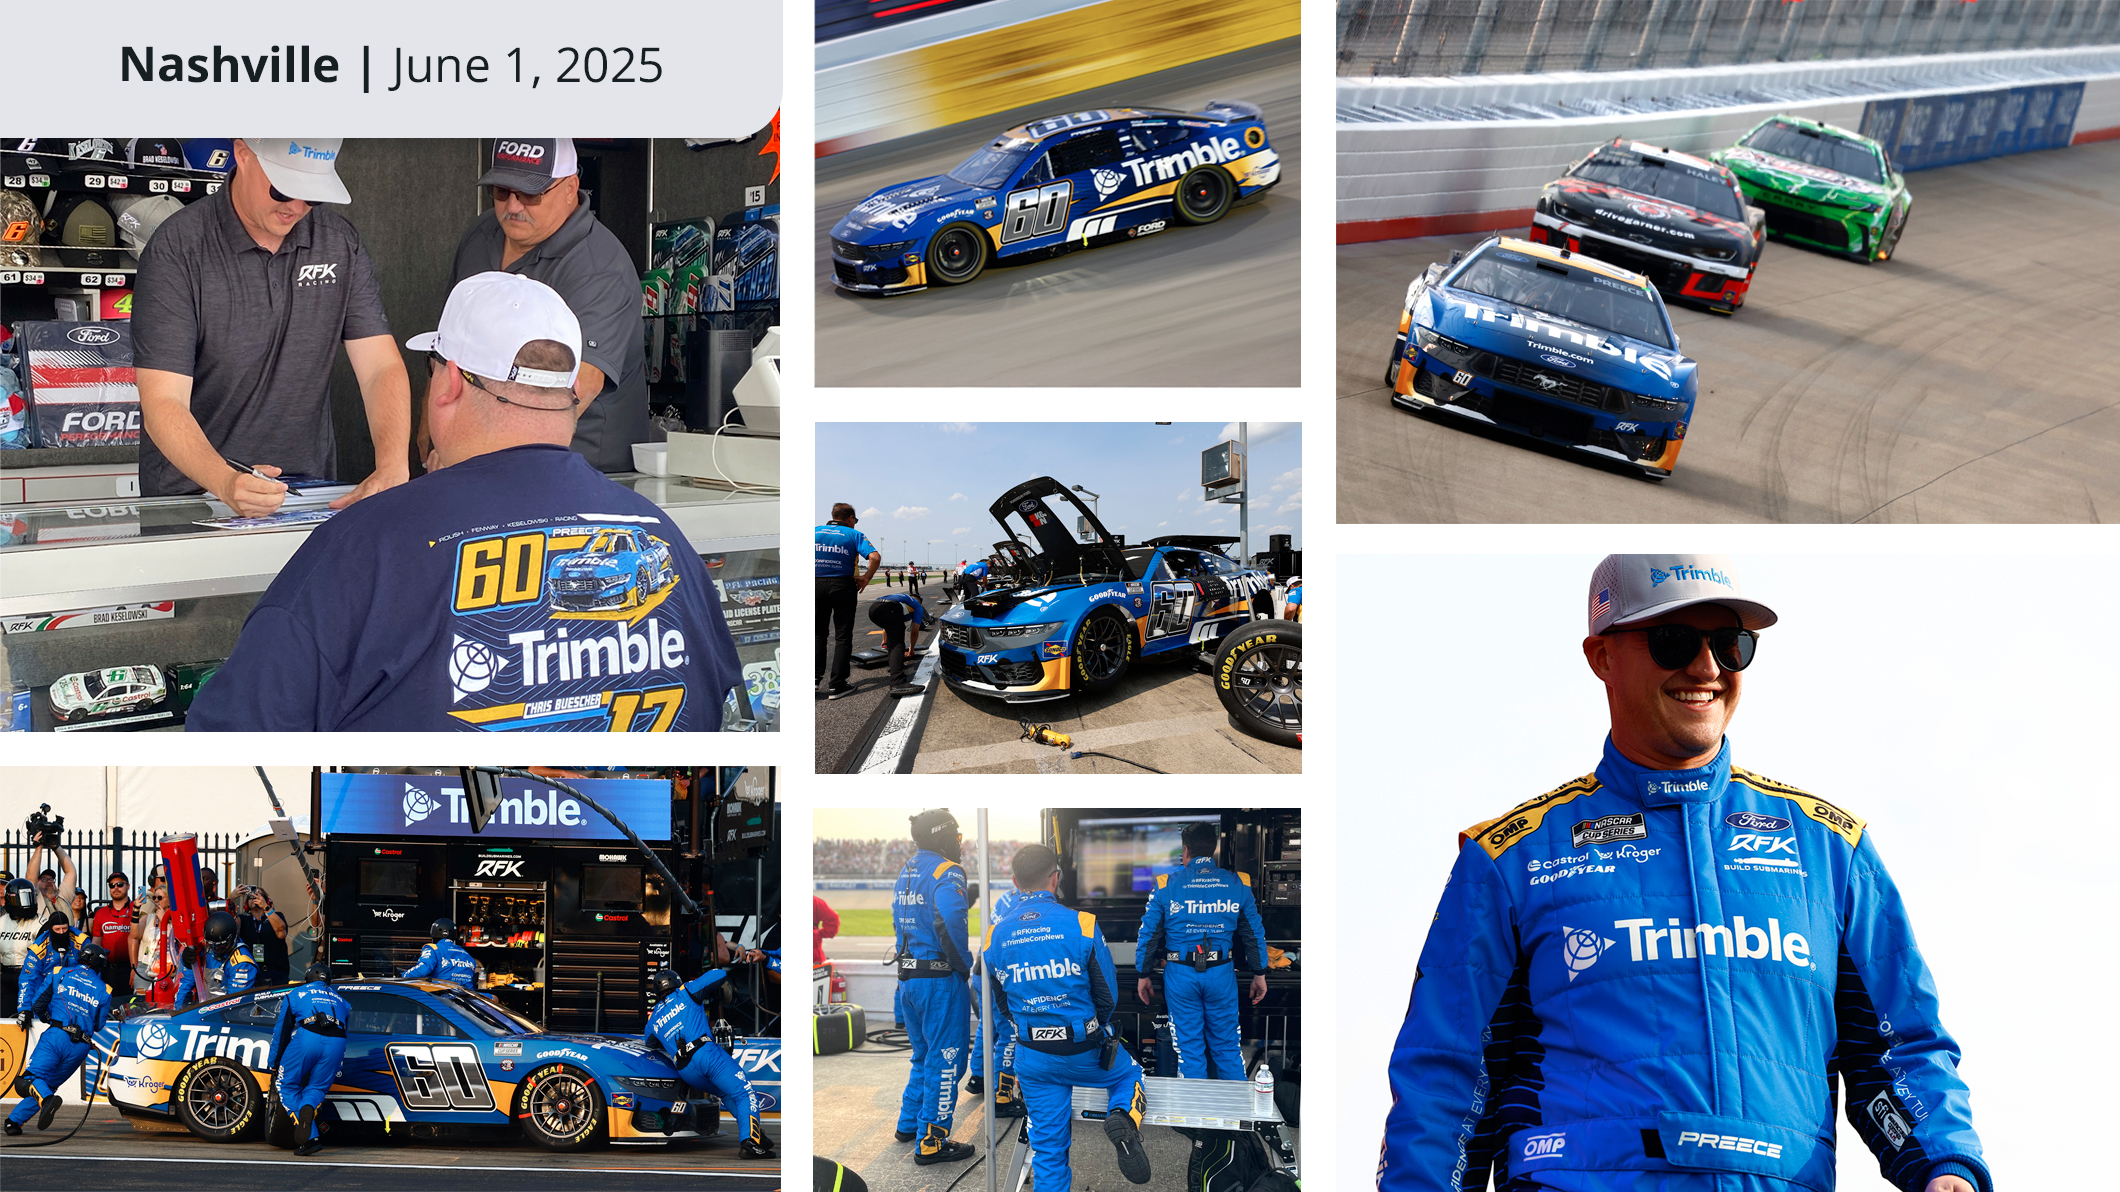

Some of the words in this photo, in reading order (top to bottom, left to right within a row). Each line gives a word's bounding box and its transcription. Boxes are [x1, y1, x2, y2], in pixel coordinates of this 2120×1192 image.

[1071, 126, 1102, 137] PREECE
[303, 145, 336, 160] Trimble
[498, 140, 545, 159] FORD
[207, 149, 230, 169] 6
[1121, 136, 1241, 187] Trimble
[89, 178, 102, 186] 29
[1687, 168, 1727, 185] HALEY
[153, 182, 165, 190] 30
[936, 208, 975, 224] GOODYEAR
[1001, 182, 1072, 245] 60
[2, 221, 29, 241] 6
[1137, 220, 1166, 233] FORD
[1595, 208, 1696, 239] drivegarner.com
[86, 276, 98, 284] 62
[298, 264, 338, 281] RFK
[298, 279, 338, 287] RACING
[1593, 277, 1644, 297] PREECE
[78, 328, 110, 342] Ford
[1464, 303, 1672, 382] Trimble
[1527, 340, 1594, 365] Trimble.com
[1549, 356, 1568, 367] Ford
[1453, 371, 1472, 387] 60
[60, 430, 140, 441] PERFORMANC
[1615, 422, 1639, 433] RFK
[438, 531, 464, 543] ROUSH
[471, 524, 499, 533] FENWAY
[507, 518, 548, 528] KESELOWSKI
[552, 527, 601, 537] PREECE
[815, 543, 849, 555] Trimble
[455, 534, 546, 611] 60
[1670, 564, 1732, 589] Trimble
[1089, 588, 1127, 602] GOODYEAR
[735, 606, 761, 618] LICENSE
[1148, 582, 1194, 639] 60
[10, 621, 33, 632] RFK
[93, 612, 110, 624] BRAD
[110, 608, 148, 622] KESELOWSKI
[508, 618, 686, 687] Trimble
[1045, 646, 1067, 654] SUNOCO
[1077, 618, 1092, 681] GOODYEAR
[977, 654, 998, 664] RFK
[1221, 634, 1278, 690] GOODYEAR
[748, 670, 778, 696] 38
[18, 703, 28, 711] 6+
[122, 692, 151, 704] Castrol
[524, 700, 552, 715] CHRIS
[554, 692, 602, 711] BUESCHER
[605, 682, 686, 732] 17
[1661, 779, 1709, 795] Trimble
[441, 787, 581, 825] Tmble
[1594, 817, 1633, 829] NASCAR
[1738, 813, 1777, 830] Ford
[1815, 805, 1853, 830] OMP
[1490, 818, 1529, 845] OMP
[1582, 830, 1602, 839] CUP
[1602, 827, 1635, 838] SERIES
[1727, 834, 1797, 855] RFK
[1543, 852, 1590, 869] Castrol
[1616, 844, 1661, 863] Kroger
[474, 860, 525, 877] RFK
[1530, 864, 1616, 886] GOODYEAR
[382, 909, 405, 922] Kroger
[1184, 900, 1240, 914] Trimble
[603, 914, 629, 922] Castrol
[1022, 912, 1036, 921] Ford
[1002, 933, 1064, 949] @TrimbleCorpNews
[1011, 926, 1051, 938] @RFKracing
[1614, 916, 1810, 967] Trimble
[1007, 958, 1082, 984] Trimble
[67, 986, 99, 1008] Trimble
[208, 997, 242, 1012] Castrol
[656, 1003, 685, 1028] Trimble
[1031, 1004, 1050, 1013] EVERY
[1051, 1001, 1071, 1010] TURN
[1034, 1029, 1065, 1039] RFK
[180, 1024, 270, 1070] Trim
[536, 1047, 588, 1061] GOODYEAR
[139, 1075, 165, 1093] Kroger
[178, 1056, 218, 1102] GOODYEAR
[388, 1044, 495, 1110] 60
[937, 1064, 957, 1121] Trimble
[1462, 1114, 1476, 1134] AT
[1471, 1068, 1489, 1115] EVERY
[671, 1101, 687, 1113] 60
[1874, 1101, 1888, 1120] sfi
[231, 1110, 252, 1135] EAGLE
[575, 1118, 598, 1143] EAGLE
[1524, 1136, 1566, 1157] OMP
[1678, 1131, 1783, 1158] PREECE
